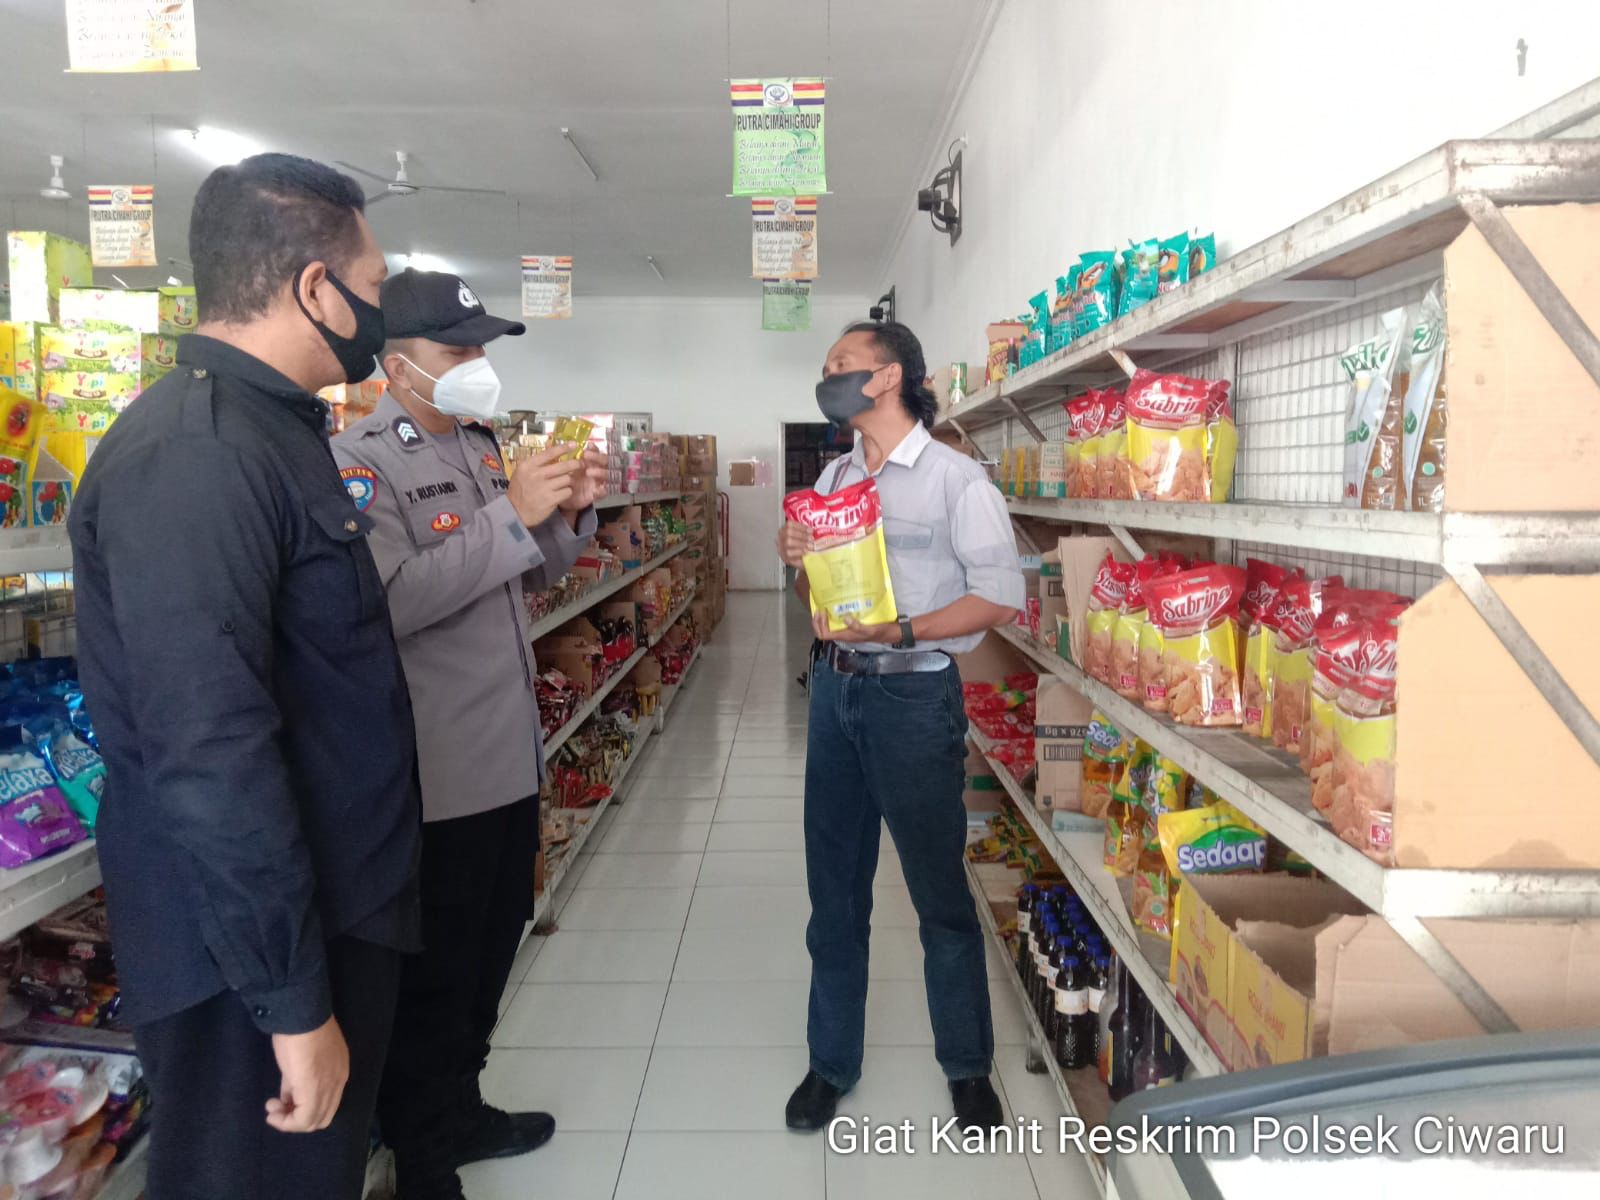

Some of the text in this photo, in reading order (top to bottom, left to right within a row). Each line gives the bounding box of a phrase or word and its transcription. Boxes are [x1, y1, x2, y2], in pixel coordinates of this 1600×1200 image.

[737, 113, 821, 131] PUTRA CIMAHI GROUP
[795, 220, 814, 232] GROUP
[76, 373, 104, 388] Ypi
[77, 413, 105, 428] Ypi
[1161, 584, 1233, 622] Sabrina
[0, 767, 54, 803] elaxa
